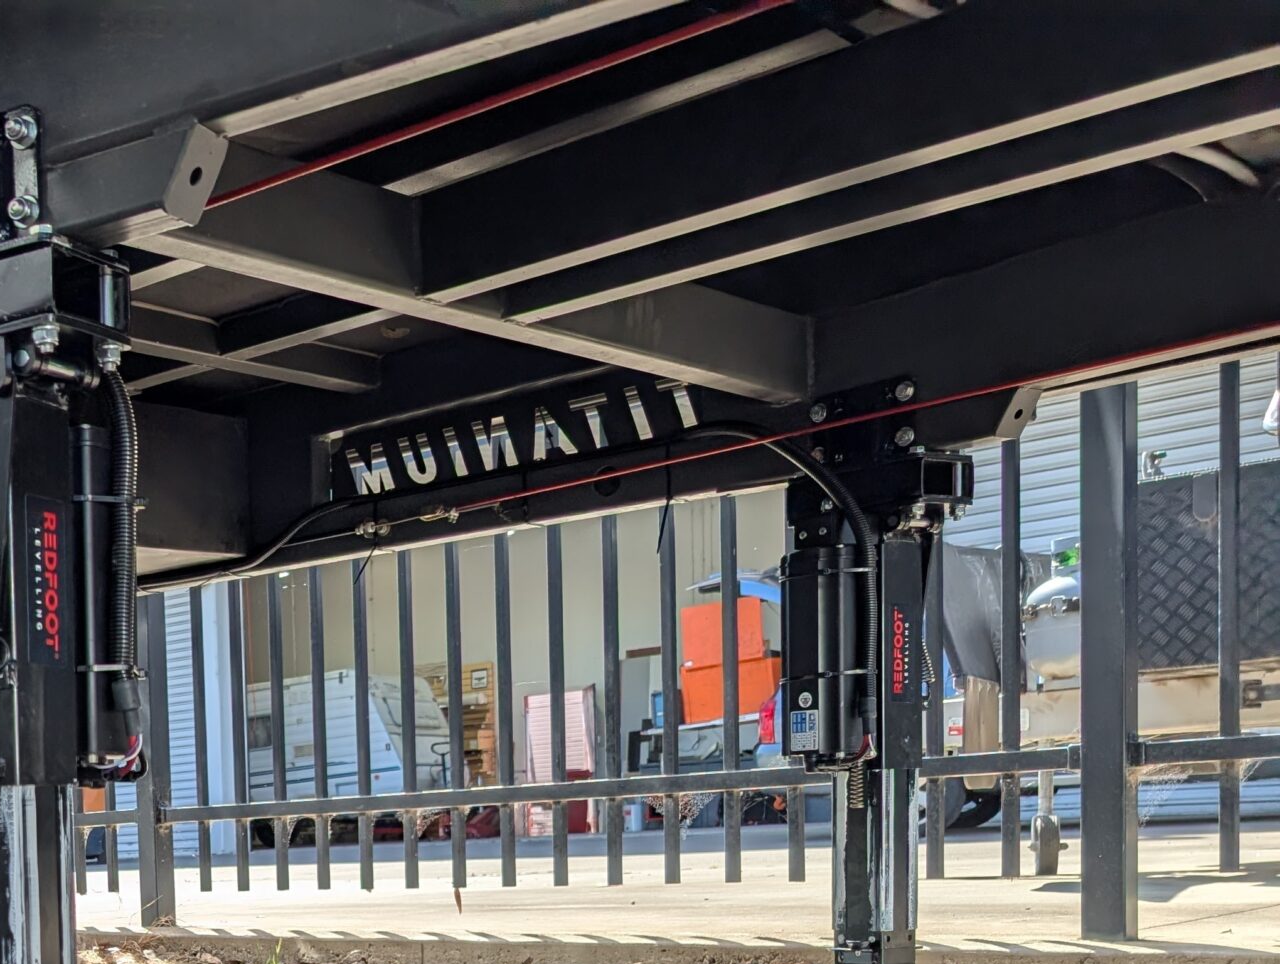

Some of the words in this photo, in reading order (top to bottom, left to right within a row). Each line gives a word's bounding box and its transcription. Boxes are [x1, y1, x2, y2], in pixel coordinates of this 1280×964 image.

[34, 527, 43, 630] LEVELLING
[43, 511, 60, 654] REDFOOT
[893, 610, 903, 693] REDFOOT
